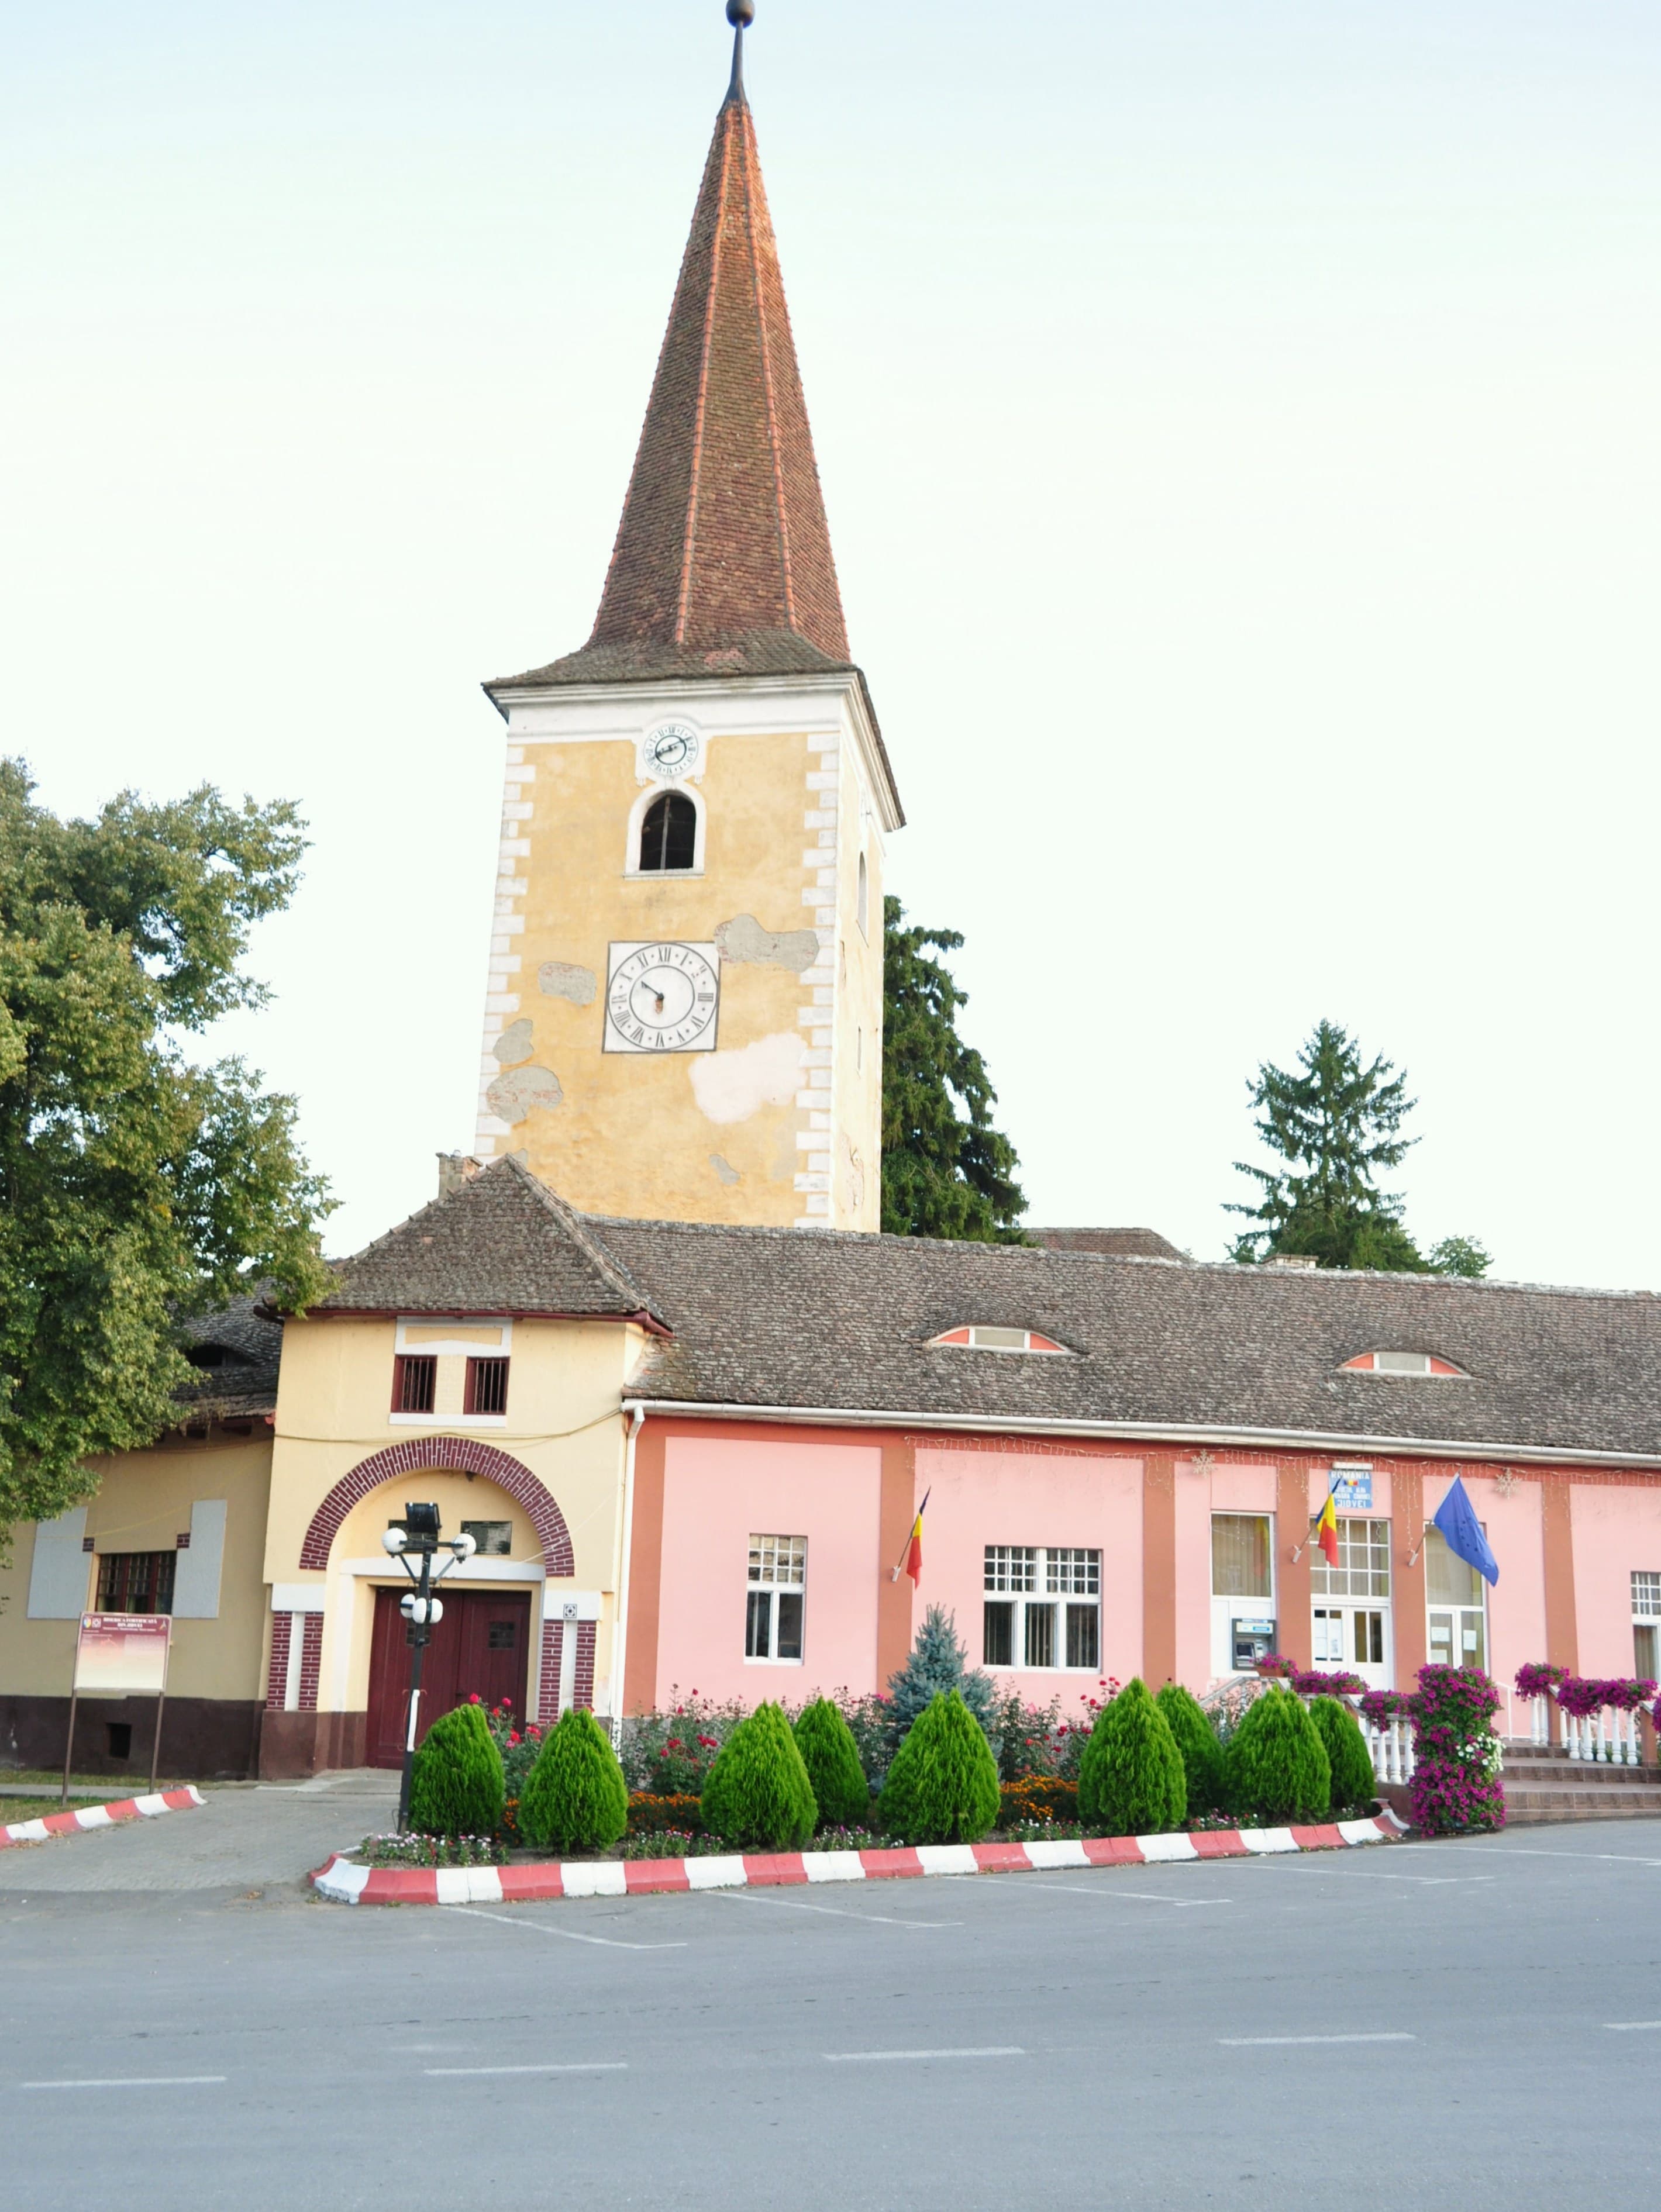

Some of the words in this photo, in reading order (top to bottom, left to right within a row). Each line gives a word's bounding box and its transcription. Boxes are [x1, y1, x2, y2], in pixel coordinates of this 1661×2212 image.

[636, 952, 649, 969] XI
[658, 947, 672, 962] XII
[680, 952, 689, 966] I
[619, 969, 633, 982] X
[611, 994, 628, 1004] IX
[698, 993, 714, 1002] III
[614, 1010, 631, 1028] VIII
[630, 1026, 645, 1044] VII
[655, 1031, 665, 1047] VI
[677, 1029, 685, 1043] V
